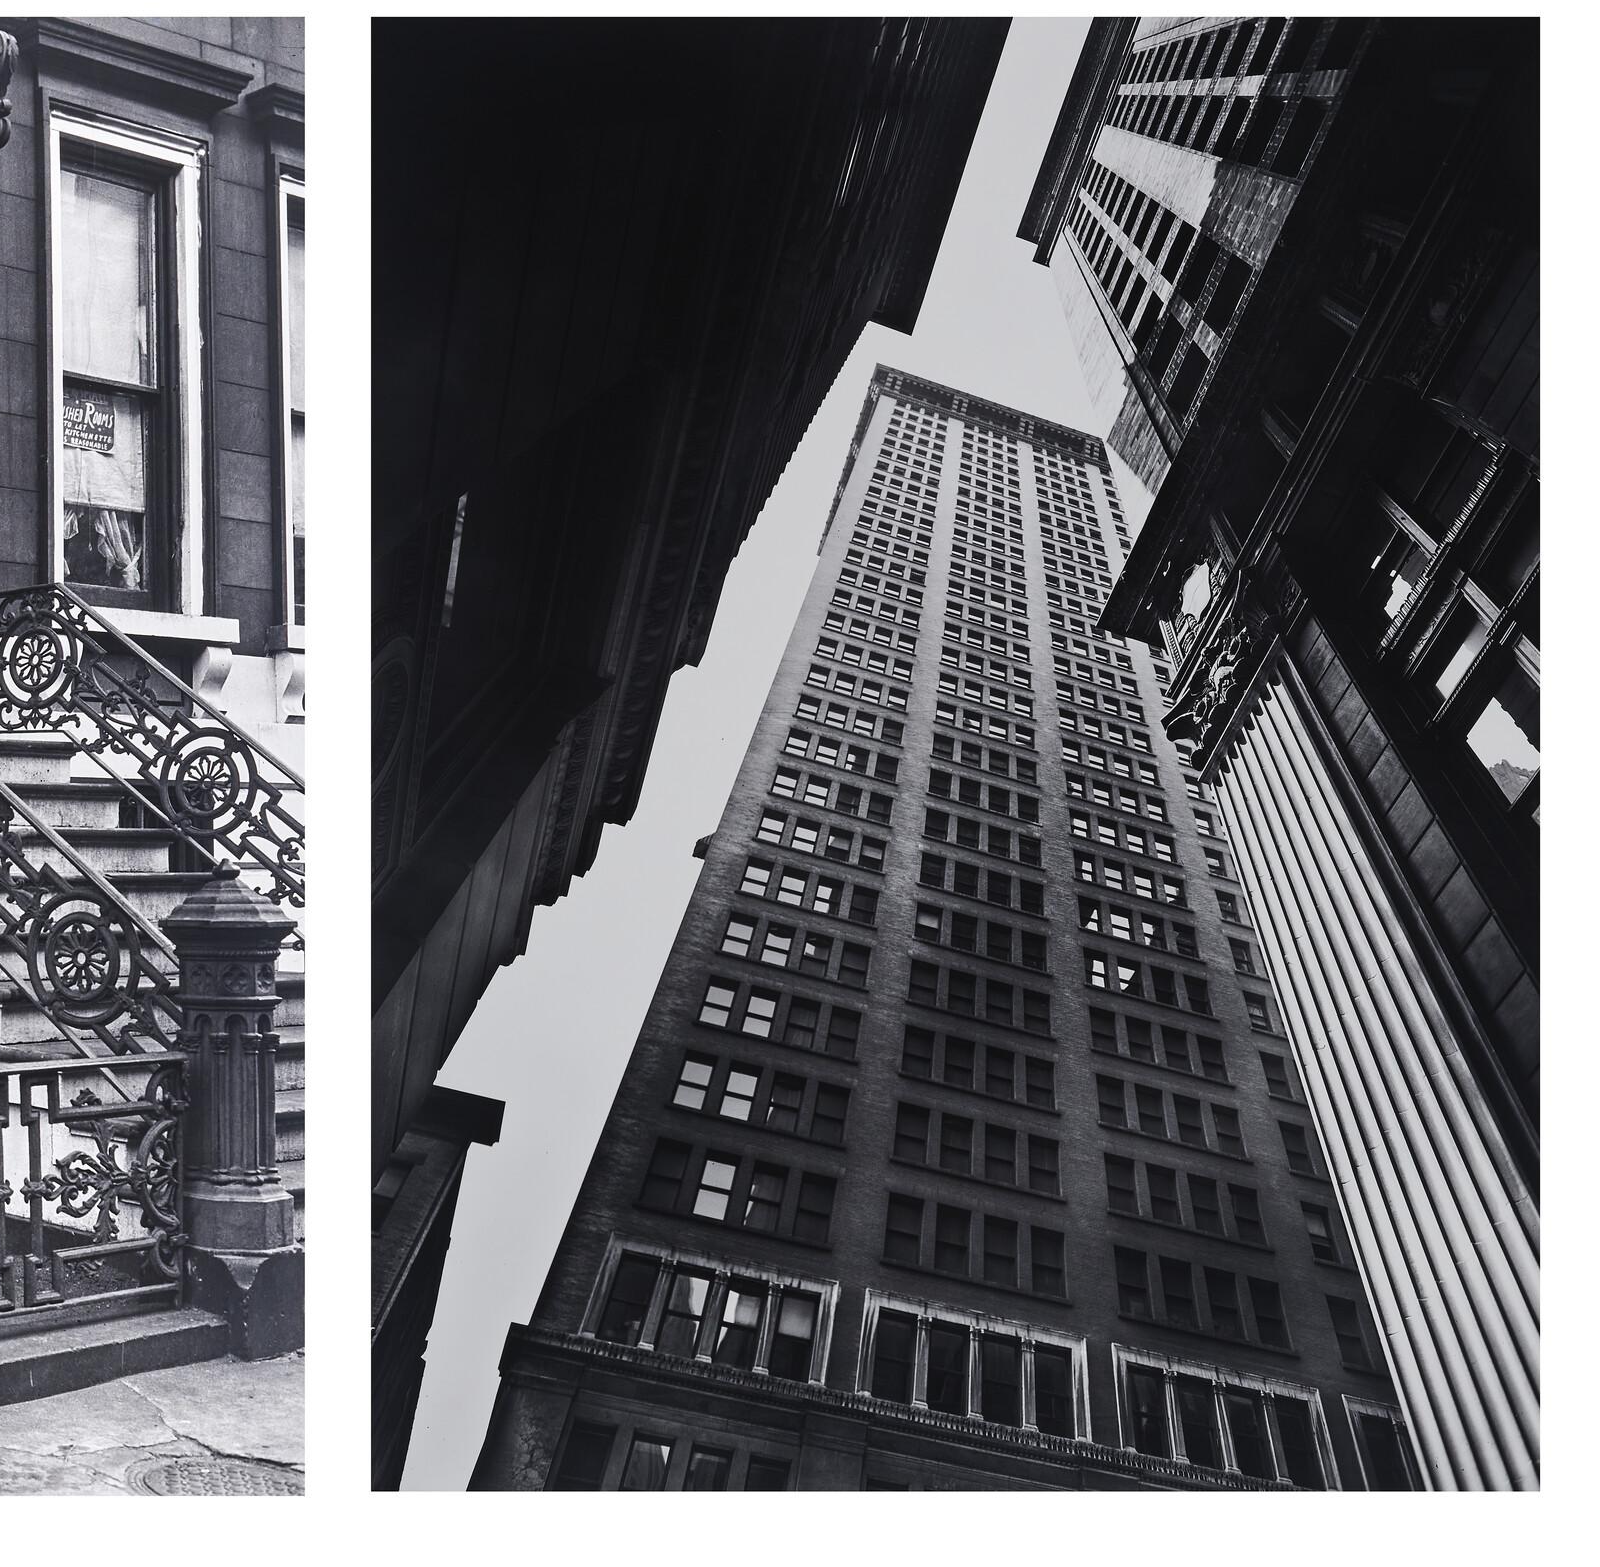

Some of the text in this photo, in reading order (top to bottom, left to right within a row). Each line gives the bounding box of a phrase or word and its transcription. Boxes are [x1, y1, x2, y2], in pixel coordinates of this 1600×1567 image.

[84, 402, 114, 429] ROOMS
[75, 423, 88, 431] LET
[65, 429, 112, 444] KITCHENETTE
[71, 437, 108, 451] REASONABLE
